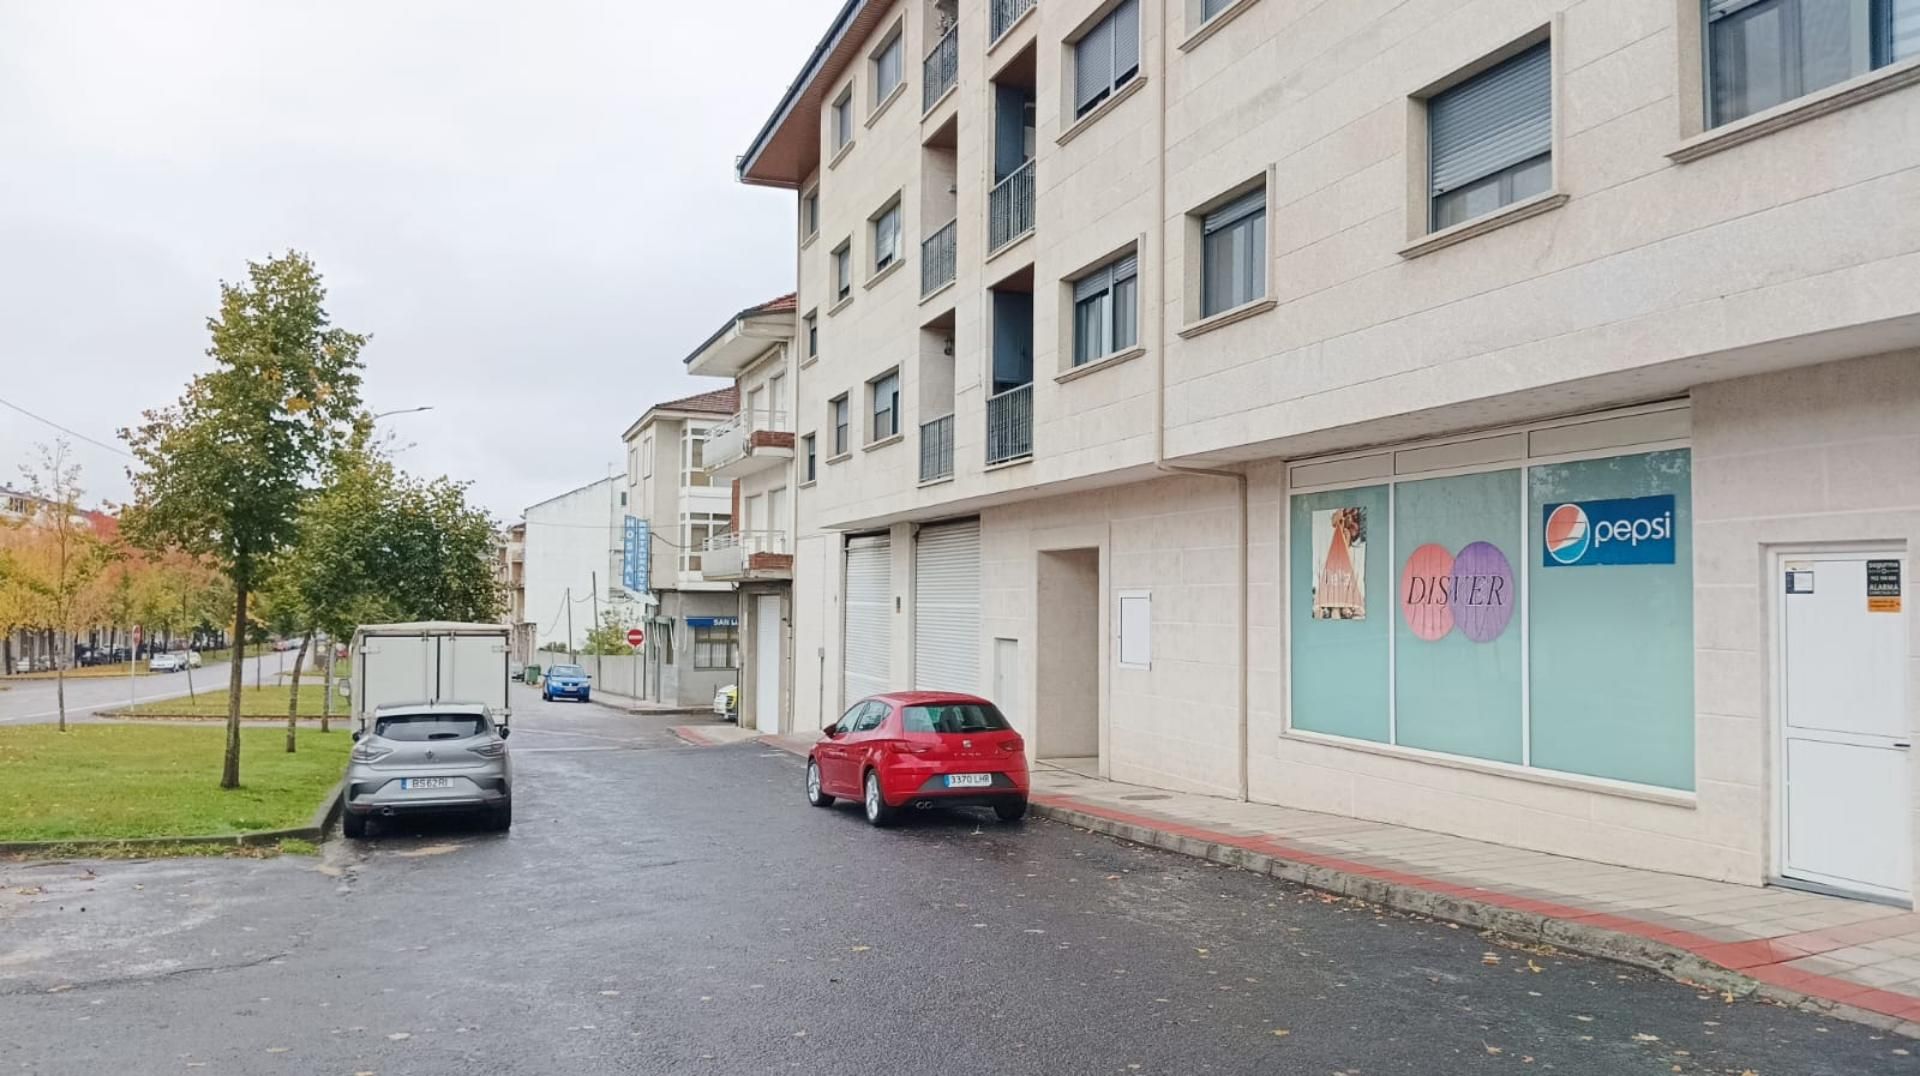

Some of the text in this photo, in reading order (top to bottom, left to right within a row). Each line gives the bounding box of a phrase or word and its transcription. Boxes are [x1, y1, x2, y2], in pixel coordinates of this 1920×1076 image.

[1594, 511, 1671, 548] pepsi
[625, 520, 634, 584] HOSTAL
[713, 618, 730, 626] SAN
[951, 775, 973, 784] 3370
